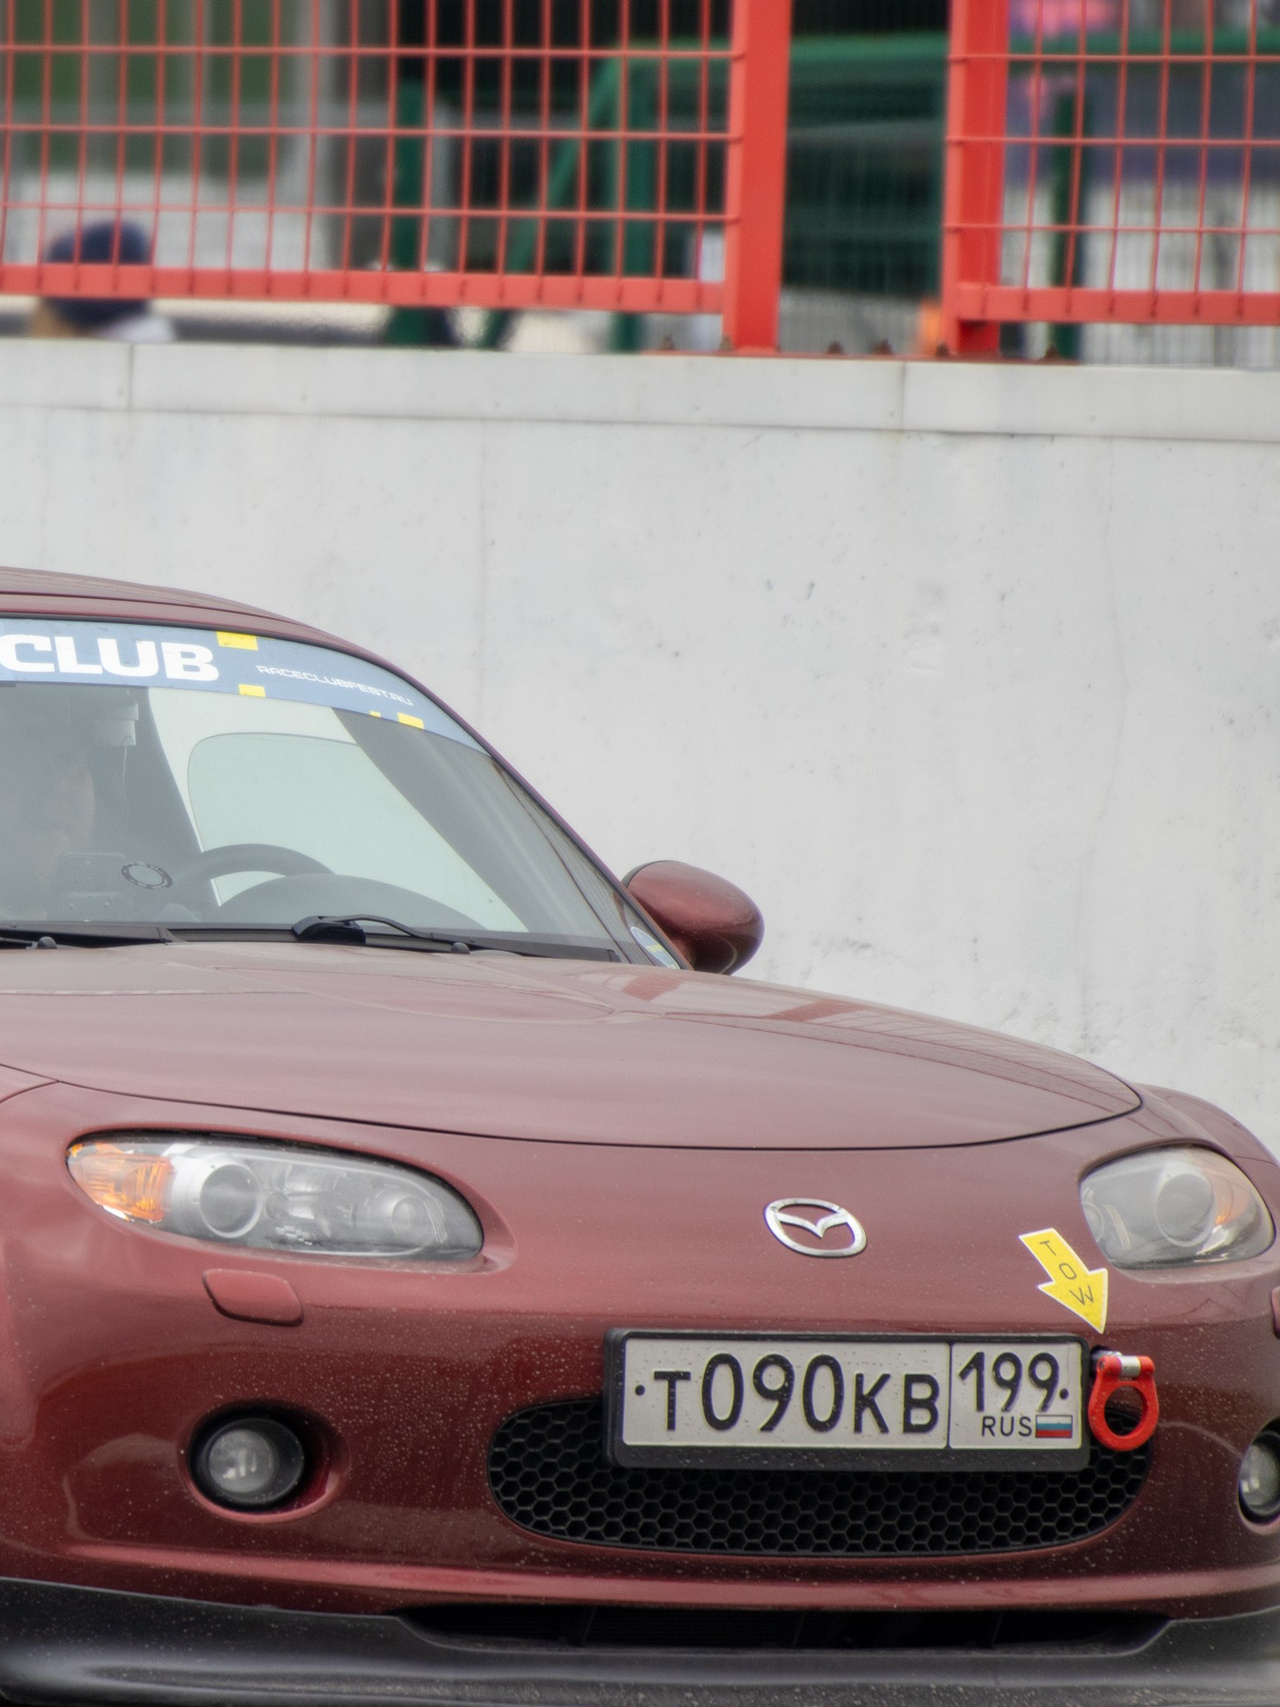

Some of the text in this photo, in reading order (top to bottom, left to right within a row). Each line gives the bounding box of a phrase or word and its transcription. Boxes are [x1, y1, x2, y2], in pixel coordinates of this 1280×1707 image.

[256, 665, 414, 707] RACECLUBFEST.RU
[1039, 1240, 1094, 1306] TOW
[958, 1351, 1060, 1412] 199
[981, 1415, 1033, 1437] RUS
